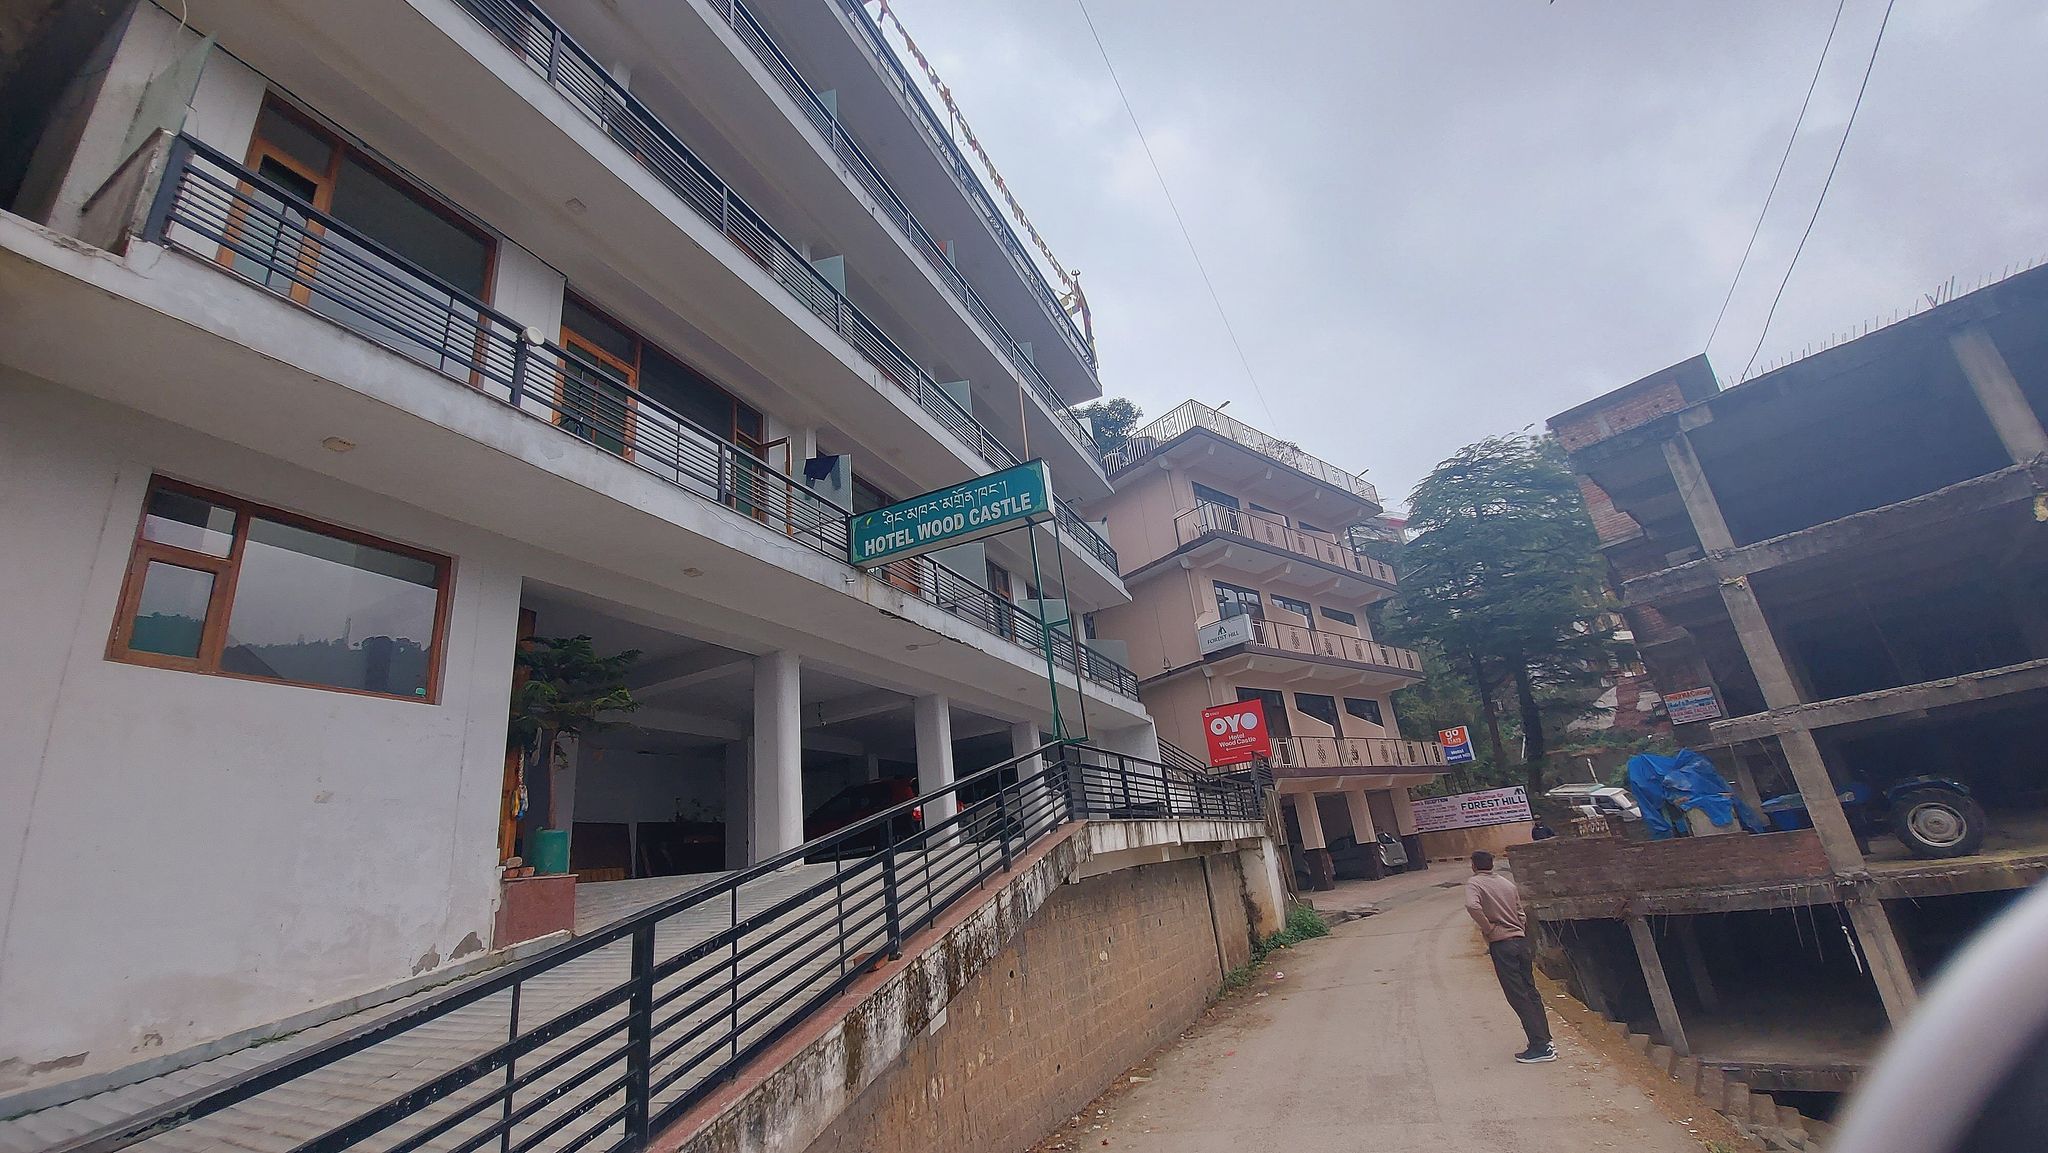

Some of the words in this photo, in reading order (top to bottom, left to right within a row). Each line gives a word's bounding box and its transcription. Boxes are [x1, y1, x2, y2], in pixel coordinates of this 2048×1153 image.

[864, 530, 914, 557] HOTEL
[917, 515, 965, 541] WOOD
[969, 492, 1032, 526] CASTLE
[1207, 633, 1227, 645] FOREST
[1228, 630, 1239, 638] HILL
[1210, 712, 1258, 735] OYO
[1445, 729, 1459, 739] go
[1219, 739, 1237, 748] Wood
[1236, 736, 1256, 745] Castle
[1461, 799, 1499, 810] FOREST
[1502, 795, 1526, 805] HILL
